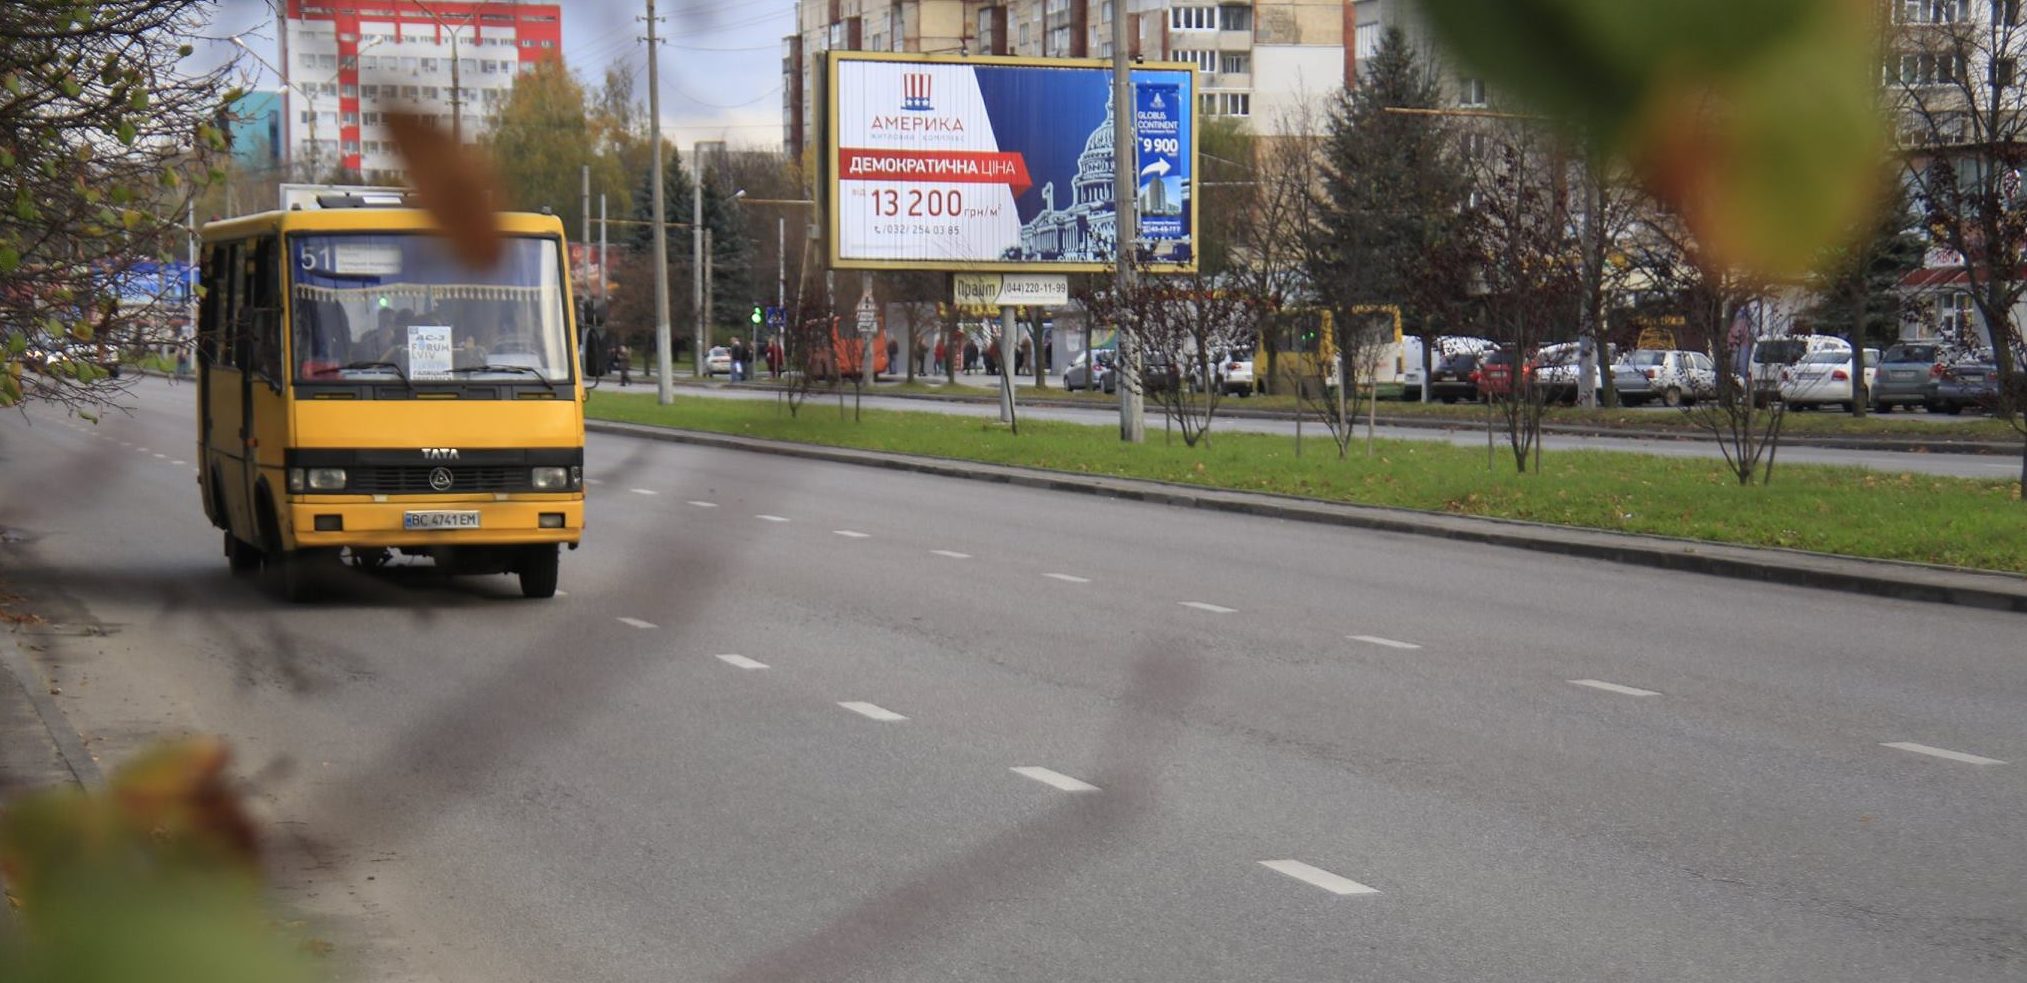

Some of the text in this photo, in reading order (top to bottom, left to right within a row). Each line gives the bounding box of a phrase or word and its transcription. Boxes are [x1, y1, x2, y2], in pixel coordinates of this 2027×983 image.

[1137, 110, 1167, 120] GLOBUS
[871, 115, 964, 132] АМЕРИКА
[1137, 120, 1179, 129] CONTINENT
[849, 156, 1016, 177] ДЕМОКРАТИЧНА ЦІНА
[871, 188, 962, 217] 13 200
[912, 225, 931, 235] 254
[933, 225, 945, 236] 03
[301, 246, 330, 270] 51
[421, 448, 460, 459] TATA
